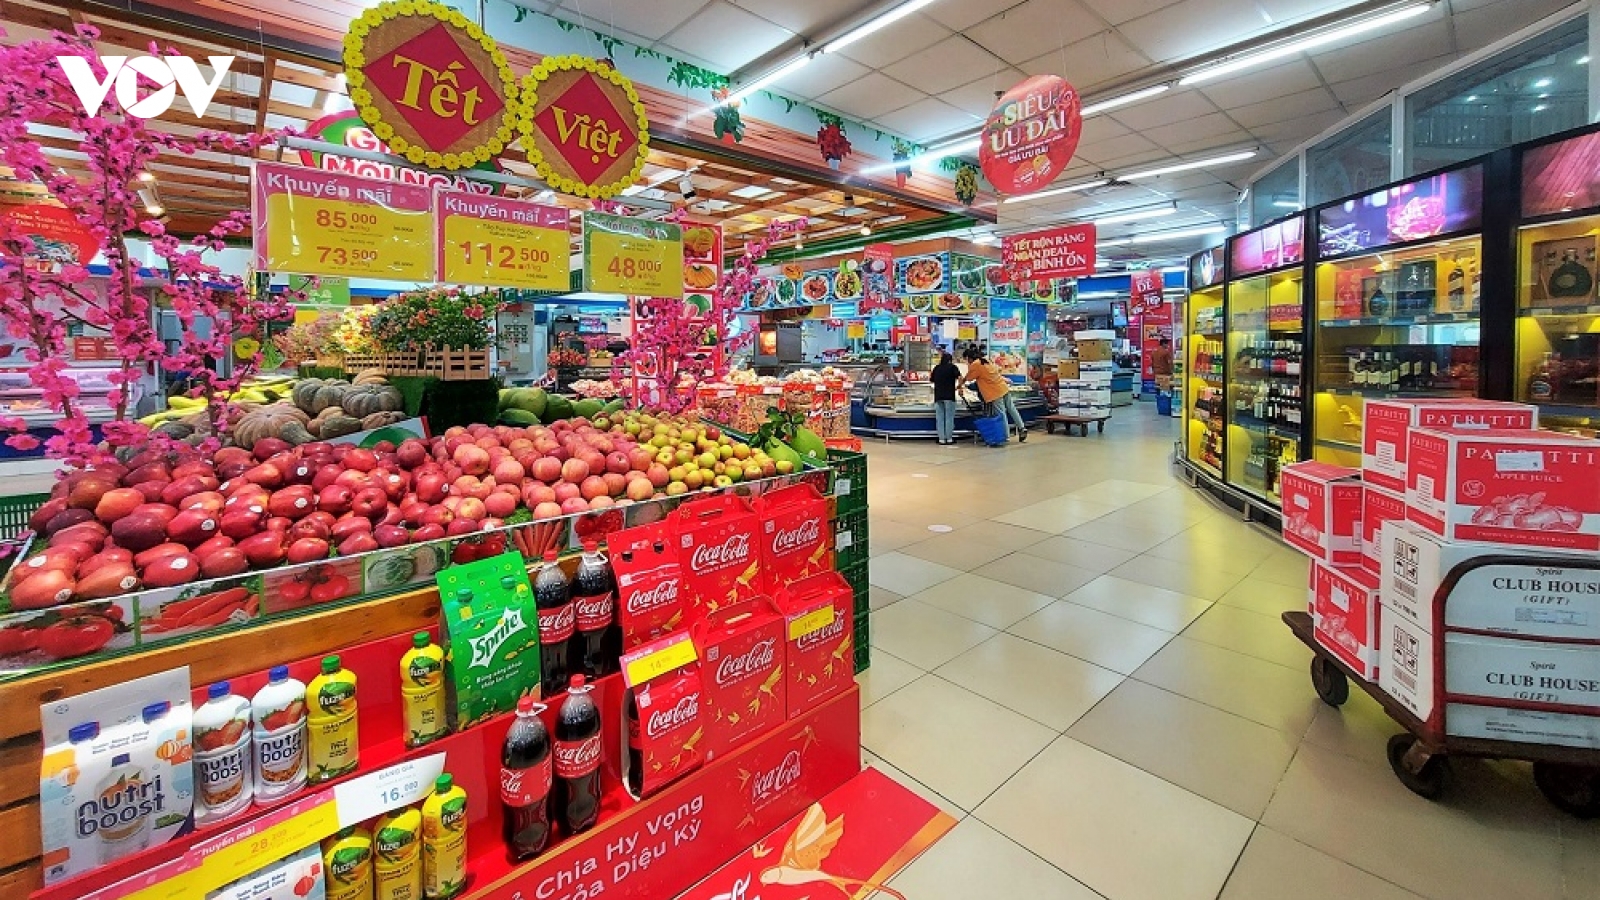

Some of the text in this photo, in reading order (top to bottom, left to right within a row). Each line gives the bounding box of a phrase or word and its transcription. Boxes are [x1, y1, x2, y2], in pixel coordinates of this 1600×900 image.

[393, 54, 483, 125] Tết
[551, 105, 623, 164] Việt
[267, 173, 392, 204] Khuyến mãi
[445, 197, 508, 219] Khuyến
[1368, 407, 1408, 420] PATRITTI
[1426, 413, 1526, 428] PATRITTI
[1412, 436, 1446, 454] PATRITTI
[1284, 475, 1323, 498] PATRITTI
[1493, 472, 1563, 483] APPLE JUICE
[691, 532, 751, 571] Coca-Cola
[773, 516, 821, 553] Coca-Cola
[627, 578, 679, 613] Coca-Cola
[1492, 577, 1542, 592] CLUB
[475, 613, 520, 663] Sprite
[716, 636, 777, 685] Coca-Cola
[1485, 671, 1600, 693] CLUB HOUSE
[647, 692, 700, 736] Coca-Cola
[79, 774, 162, 818] nutri
[79, 793, 166, 836] boost
[535, 794, 704, 899] Chia Hy Vọng
[612, 840, 668, 884] Diệu
